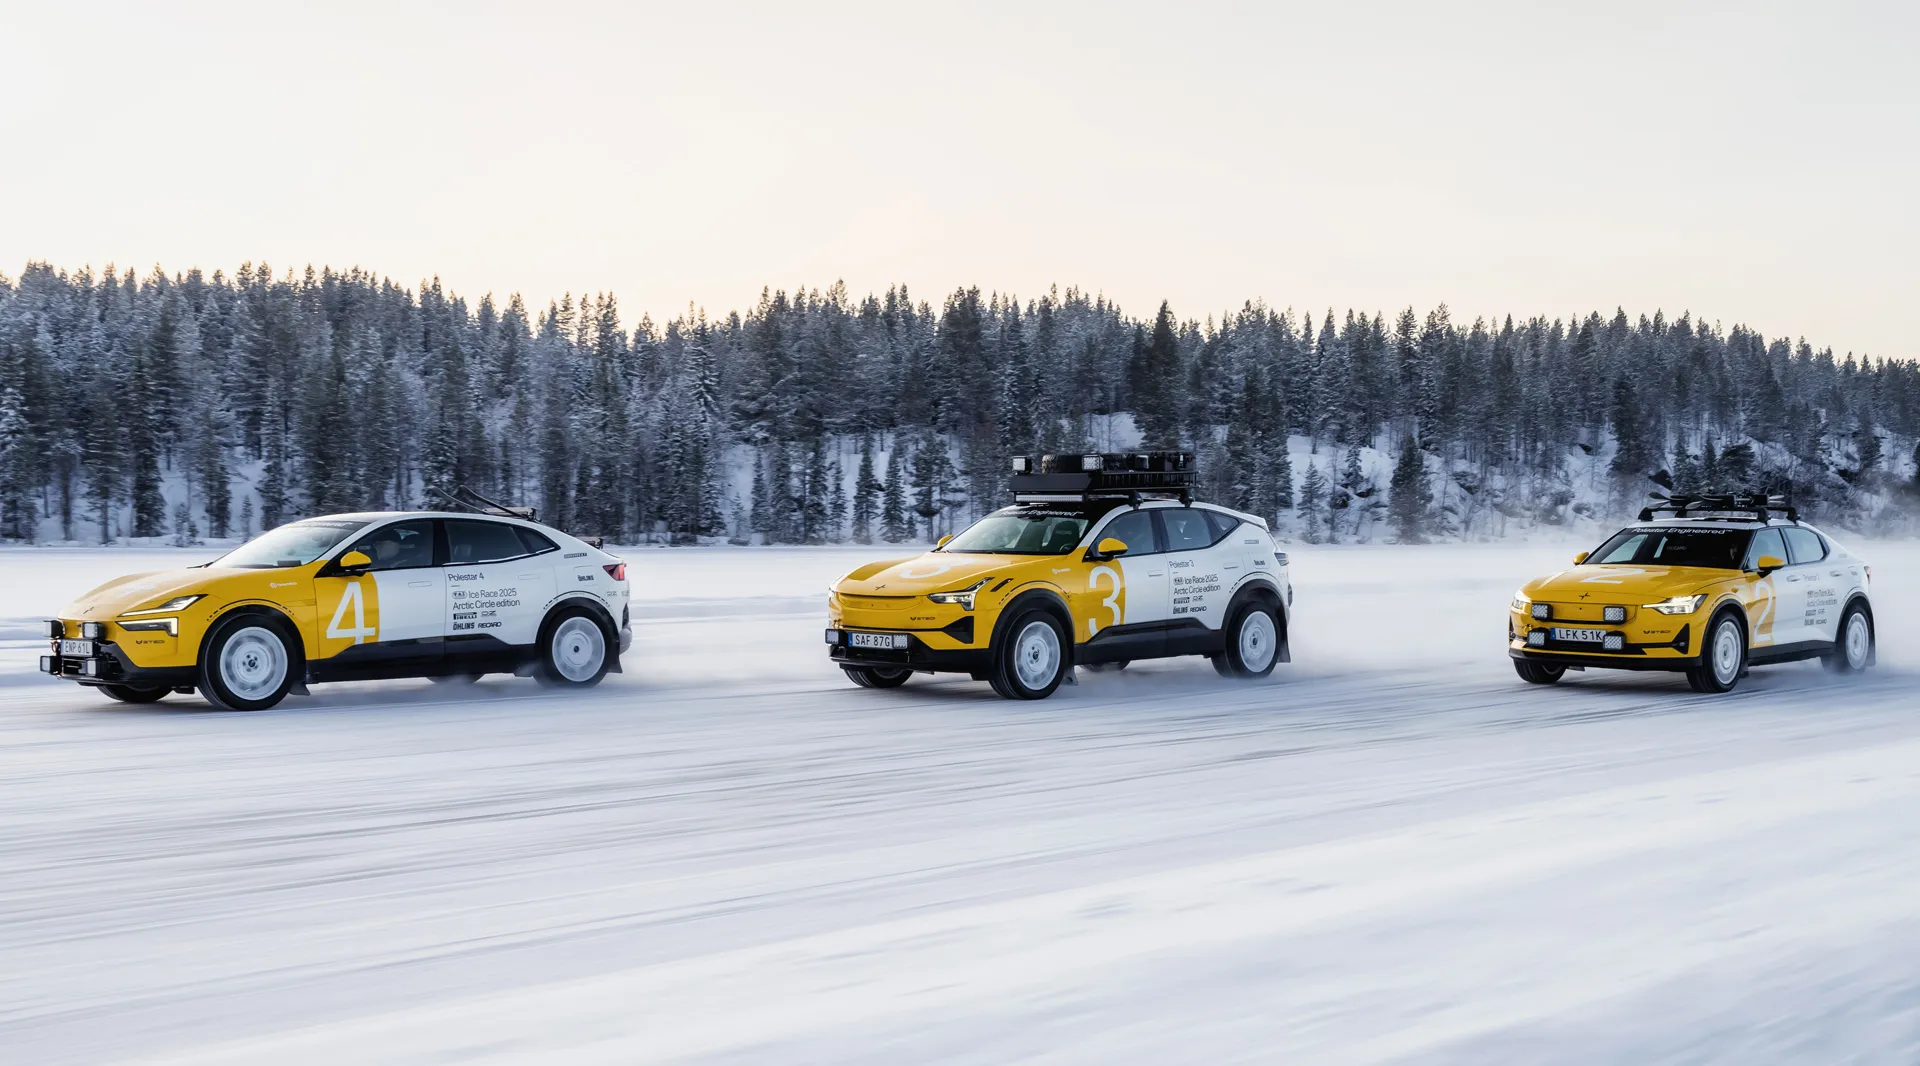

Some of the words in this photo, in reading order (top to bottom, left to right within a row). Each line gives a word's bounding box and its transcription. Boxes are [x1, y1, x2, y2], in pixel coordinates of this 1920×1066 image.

[448, 573, 478, 581] Polestar
[1192, 576, 1205, 584] Race
[1205, 574, 1219, 582] 2025
[480, 590, 498, 598] Race
[499, 588, 517, 597] 2025
[1189, 586, 1202, 594] Circle
[1203, 584, 1221, 592] edition
[452, 601, 475, 610] Arctic
[475, 600, 495, 608] Circle
[496, 599, 520, 608] edition
[1088, 566, 1121, 637] 3
[326, 582, 376, 644] 4
[1754, 580, 1773, 643] 2
[453, 622, 475, 630] ÖHLINS
[1559, 629, 1578, 640] LFK
[1582, 630, 1602, 641] 51K
[855, 635, 870, 646] SAF
[873, 636, 890, 647] 87G
[65, 641, 76, 653] ENP
[77, 642, 90, 654] 61L
